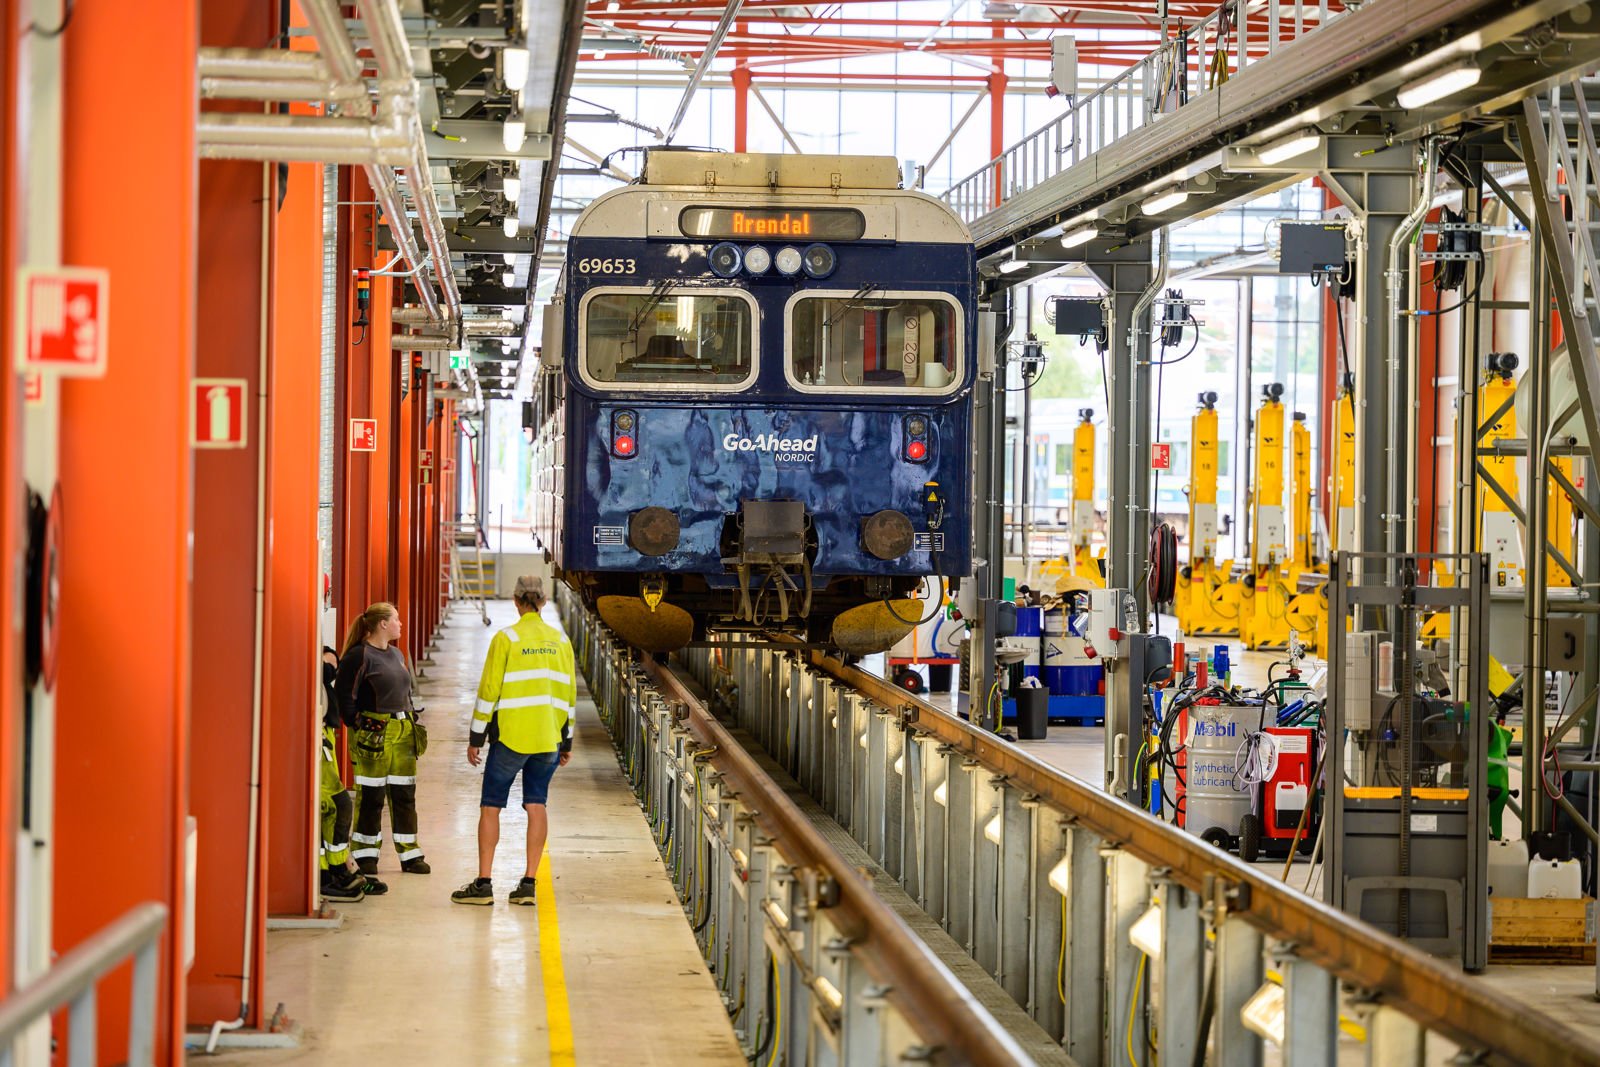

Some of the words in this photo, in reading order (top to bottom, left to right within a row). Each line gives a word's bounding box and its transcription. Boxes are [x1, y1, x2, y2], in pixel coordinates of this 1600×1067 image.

[733, 212, 810, 234] Arendal
[578, 258, 637, 274] 69653
[723, 433, 818, 452] GoAhead
[775, 453, 815, 462] NORDIC
[1194, 721, 1236, 737] Mobil
[1194, 762, 1236, 775] Synthetic
